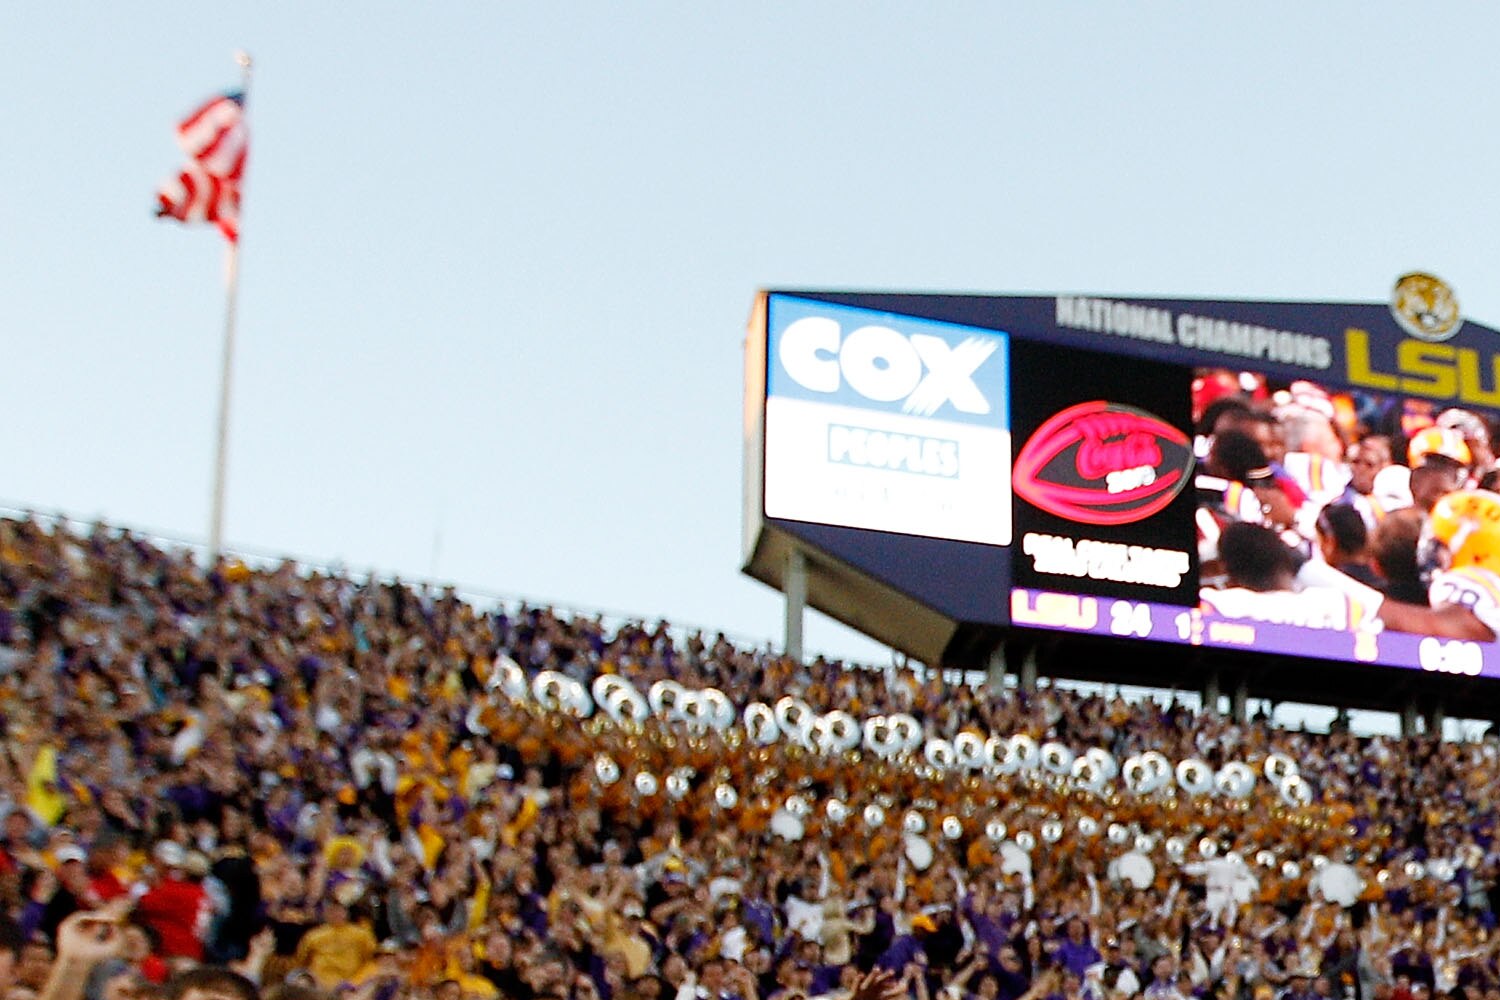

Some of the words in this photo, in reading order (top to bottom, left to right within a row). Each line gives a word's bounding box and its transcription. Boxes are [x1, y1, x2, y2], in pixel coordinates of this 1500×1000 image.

[779, 316, 999, 416] COX
[1055, 296, 1176, 344] NATIONAL
[1177, 313, 1332, 369] CHAMPIONS
